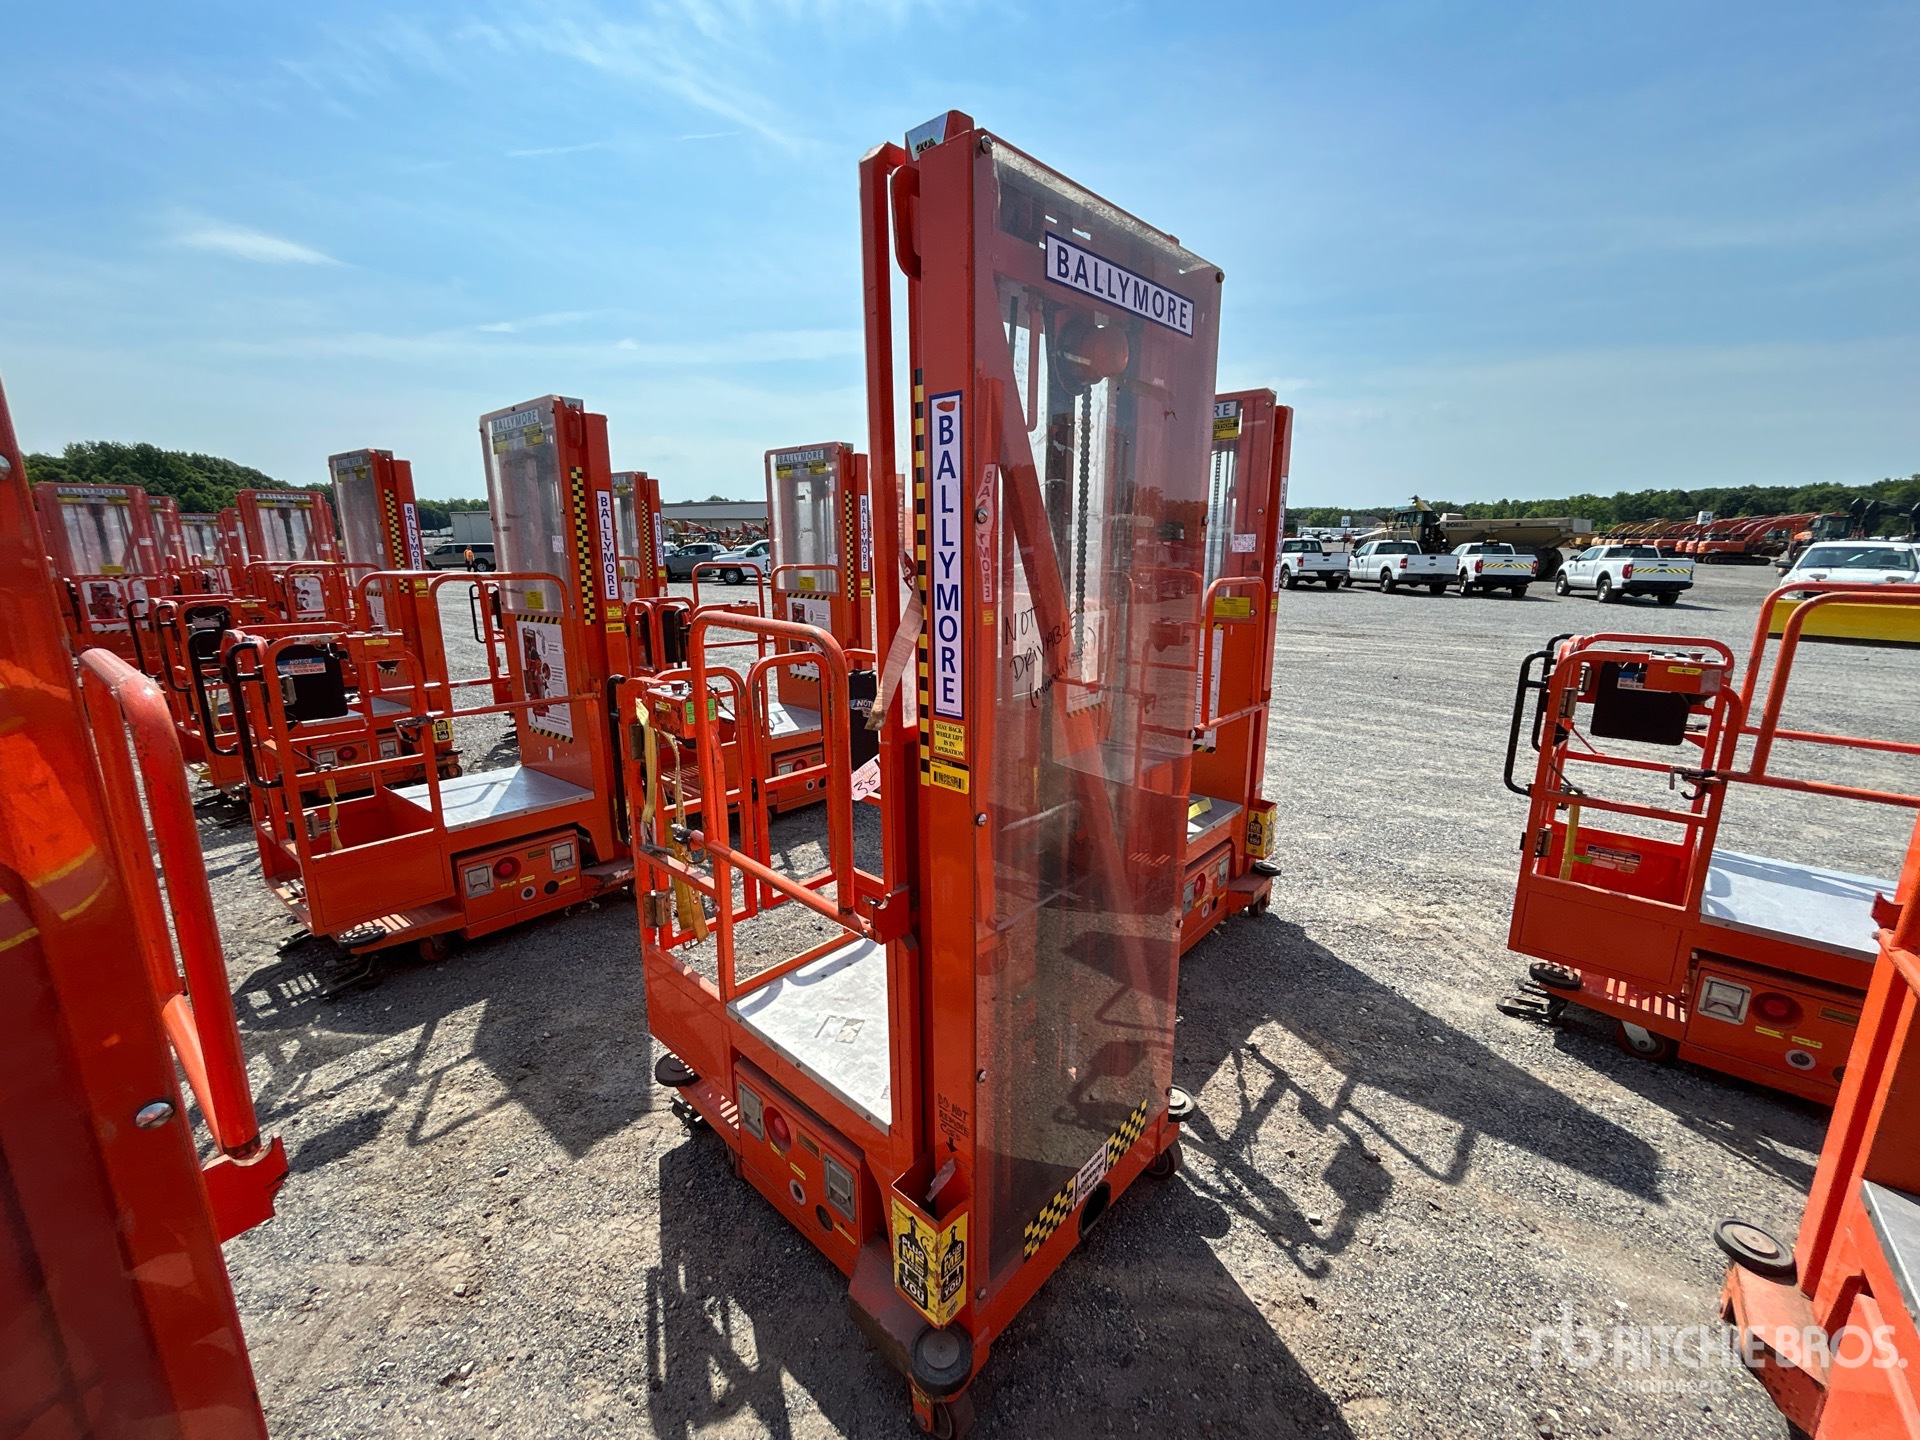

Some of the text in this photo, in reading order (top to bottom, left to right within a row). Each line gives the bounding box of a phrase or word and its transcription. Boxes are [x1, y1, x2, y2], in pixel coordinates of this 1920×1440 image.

[1057, 244, 1188, 330] BALLYMORE
[493, 409, 537, 433] BALLYMORE
[779, 450, 822, 464] BALLYMORE
[60, 487, 123, 496] BALLYMORE
[600, 496, 616, 596] BALLYMORE
[936, 414, 959, 704] BALLYMORE
[1005, 605, 1039, 645] NOT
[935, 731, 951, 739] WHILE
[948, 725, 963, 734] BACK
[935, 746, 964, 757] OPERATION
[901, 1236, 925, 1259] PLUG
[944, 1242, 962, 1261] PLUG
[902, 1247, 925, 1273] ME
[943, 1251, 962, 1272] ME
[902, 1275, 925, 1303] YOU
[944, 1275, 962, 1299] YOU
